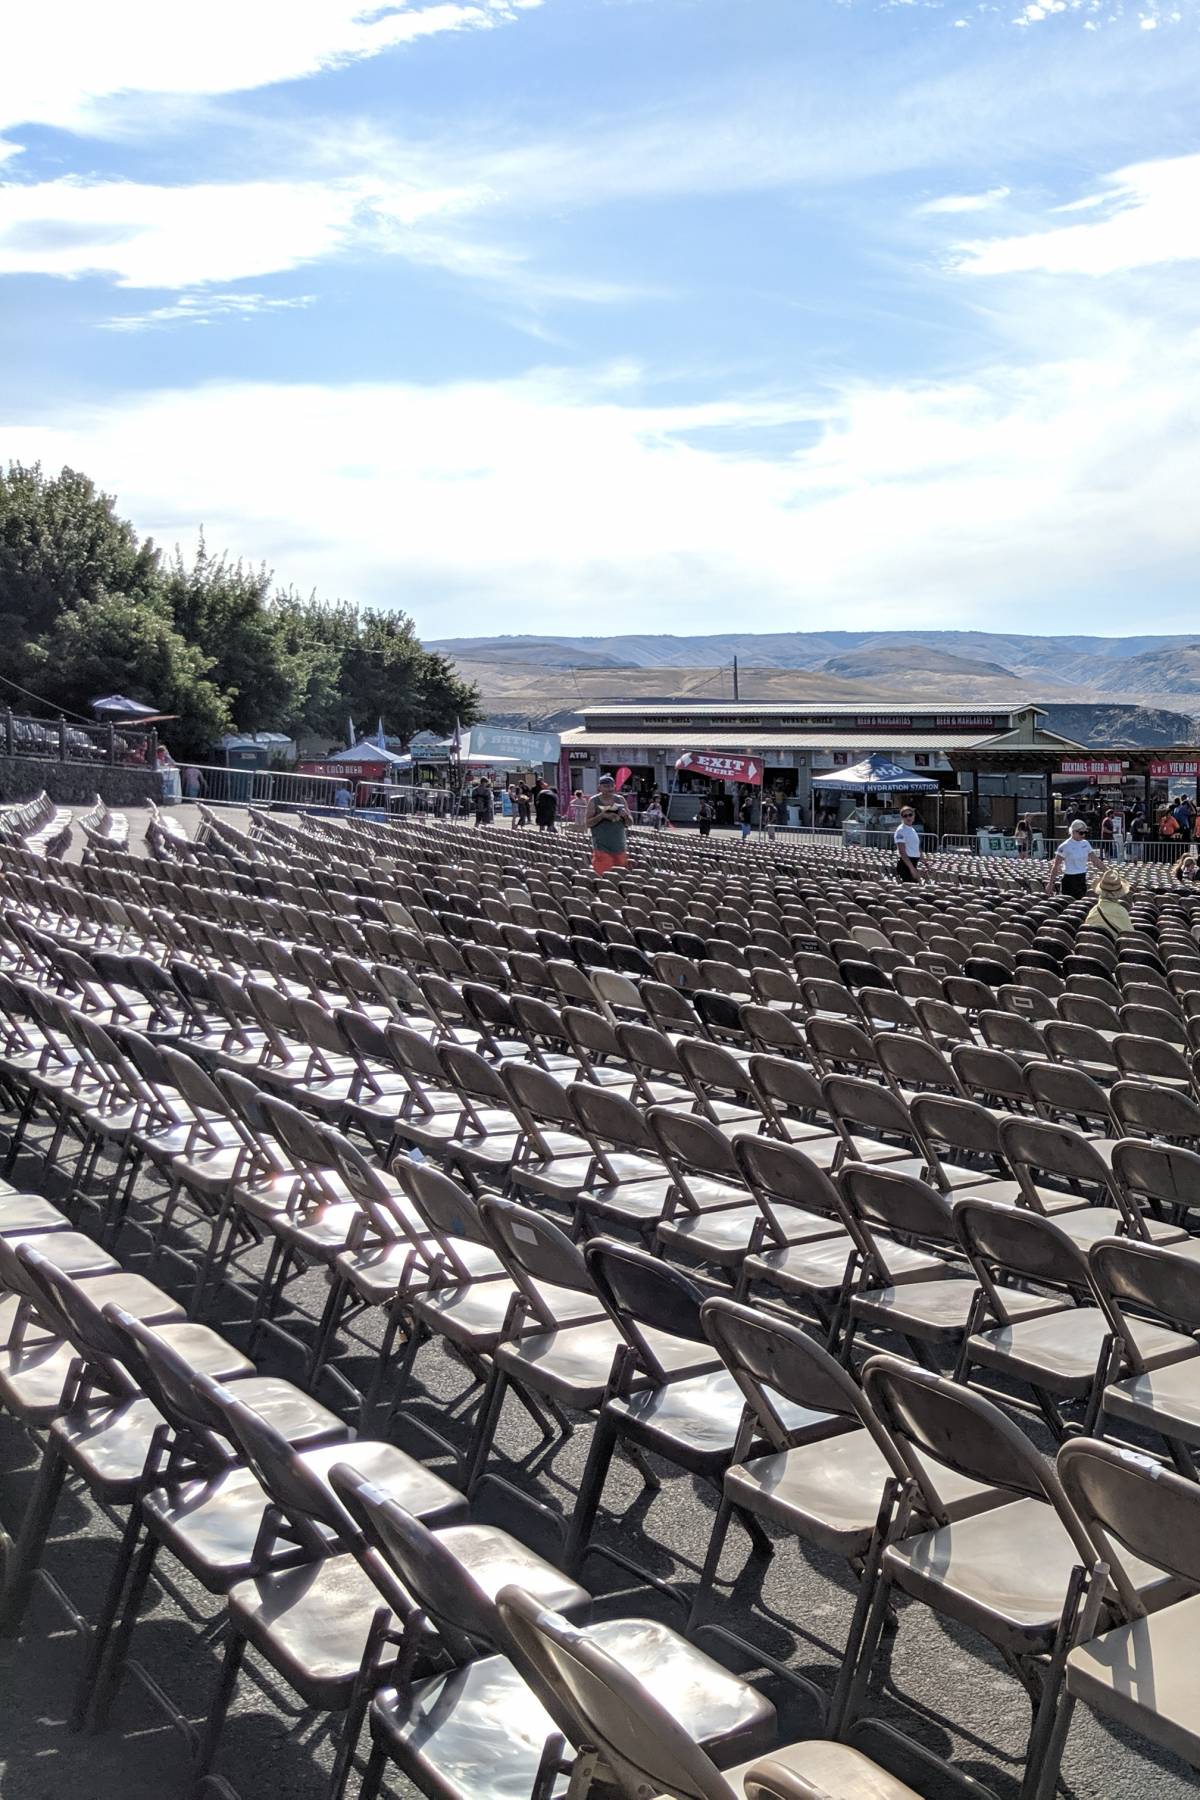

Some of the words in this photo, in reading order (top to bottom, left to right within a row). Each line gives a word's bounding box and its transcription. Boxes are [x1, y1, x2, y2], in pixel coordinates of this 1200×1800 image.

[569, 751, 588, 759] ATM
[696, 756, 744, 771] EXIT
[1061, 762, 1088, 772] COCKTAILS
[1090, 763, 1105, 772] BEER
[1108, 763, 1121, 772] WINE
[1169, 762, 1184, 773] VIEW
[1185, 762, 1198, 773] BAR
[345, 765, 362, 774] BEER
[704, 766, 734, 776] HERE
[867, 783, 908, 792] HYDRATION
[911, 783, 939, 792] STATION
